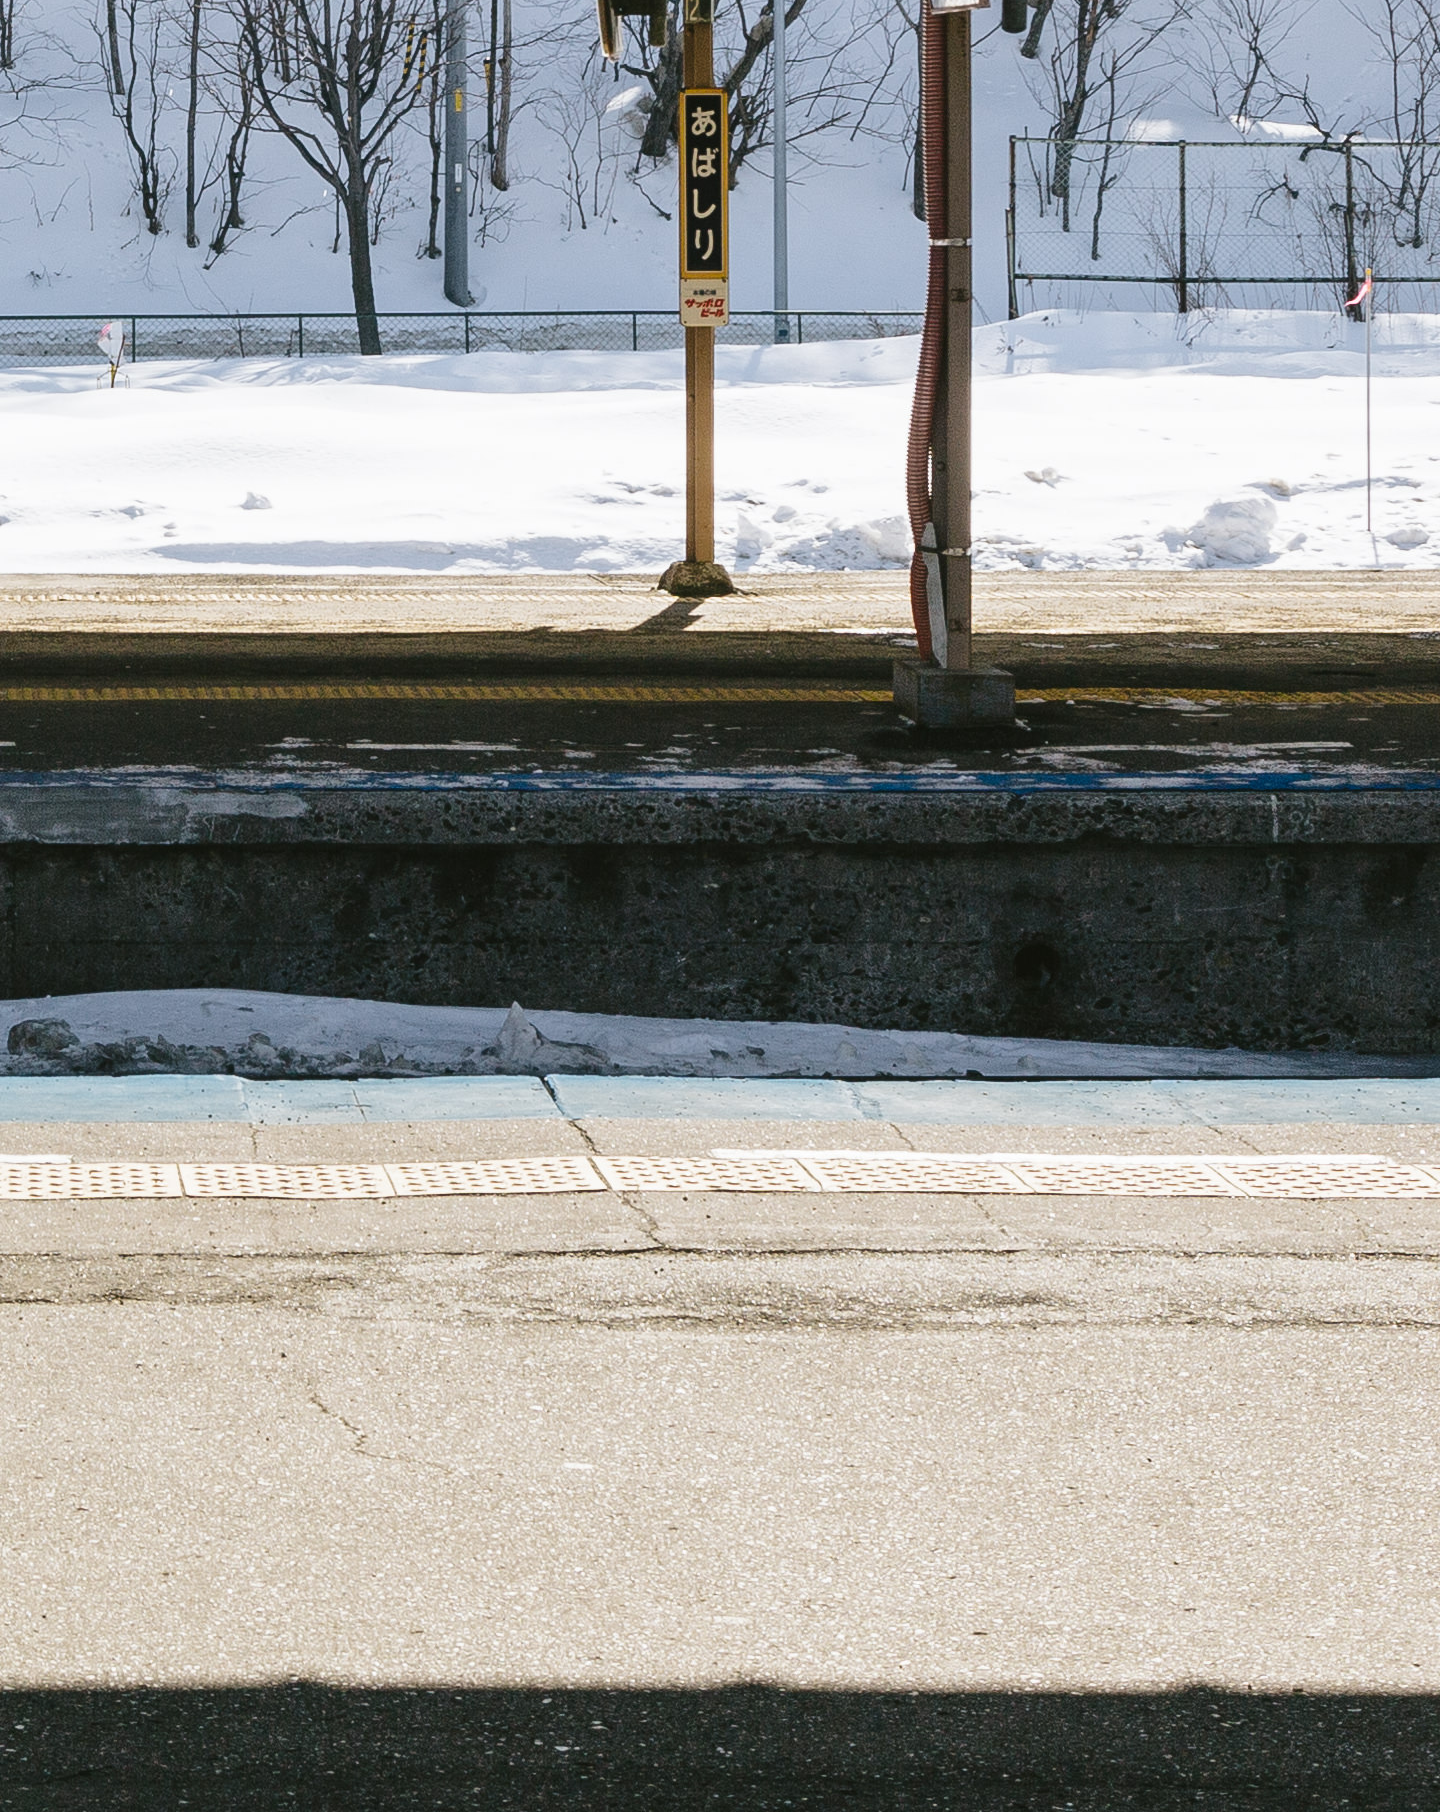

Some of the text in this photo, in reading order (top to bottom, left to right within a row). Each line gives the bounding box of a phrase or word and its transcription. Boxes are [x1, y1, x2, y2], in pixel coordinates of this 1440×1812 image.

[690, 106, 720, 261] あばしり
[684, 297, 726, 309] サッポロ
[700, 307, 726, 318] ビール
